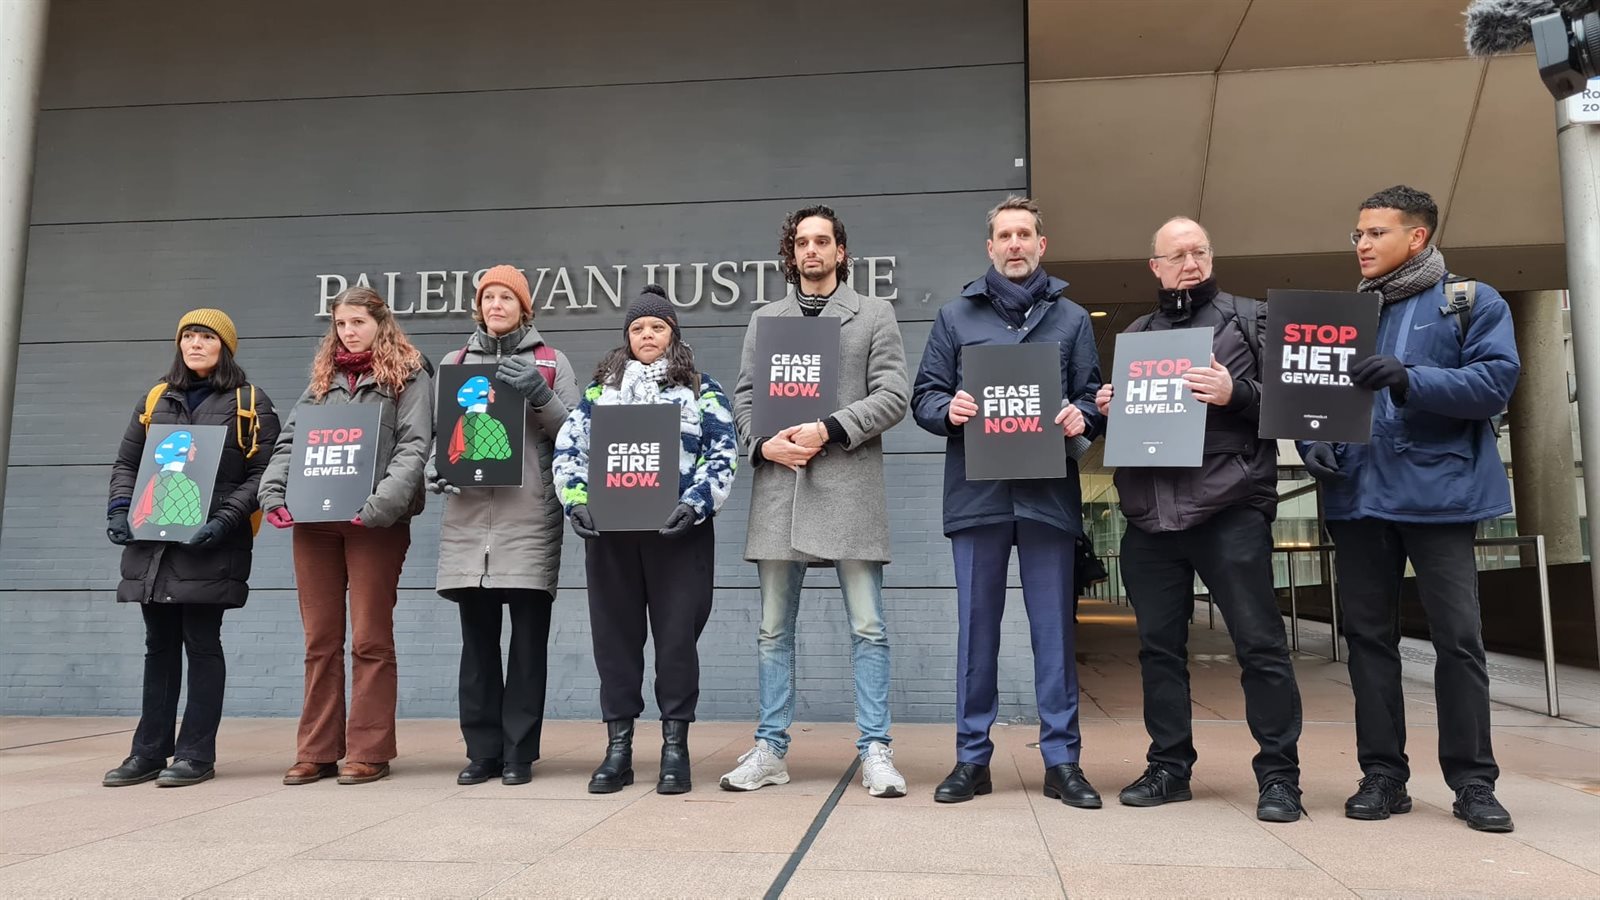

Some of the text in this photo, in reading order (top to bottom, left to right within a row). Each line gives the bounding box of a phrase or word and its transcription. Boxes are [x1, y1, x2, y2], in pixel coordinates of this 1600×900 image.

[1284, 324, 1358, 345] STOP
[772, 354, 821, 365] CEASE
[1282, 345, 1357, 371] HET
[770, 366, 820, 382] FIRE
[1128, 358, 1191, 378] STOP
[1281, 372, 1354, 386] GEWELD.
[769, 382, 820, 398] NOW.
[984, 384, 1040, 398] CEASE
[1125, 379, 1187, 402] HET
[984, 398, 1041, 416] FIRE
[1125, 403, 1187, 415] GEWELD.
[985, 417, 1043, 433] NOW.
[308, 427, 363, 445] STOP
[303, 444, 361, 466] HET
[608, 443, 660, 454] CEASE
[607, 455, 660, 472] FIRE
[303, 466, 358, 478] GEWELD.
[606, 472, 659, 488] NOW.
